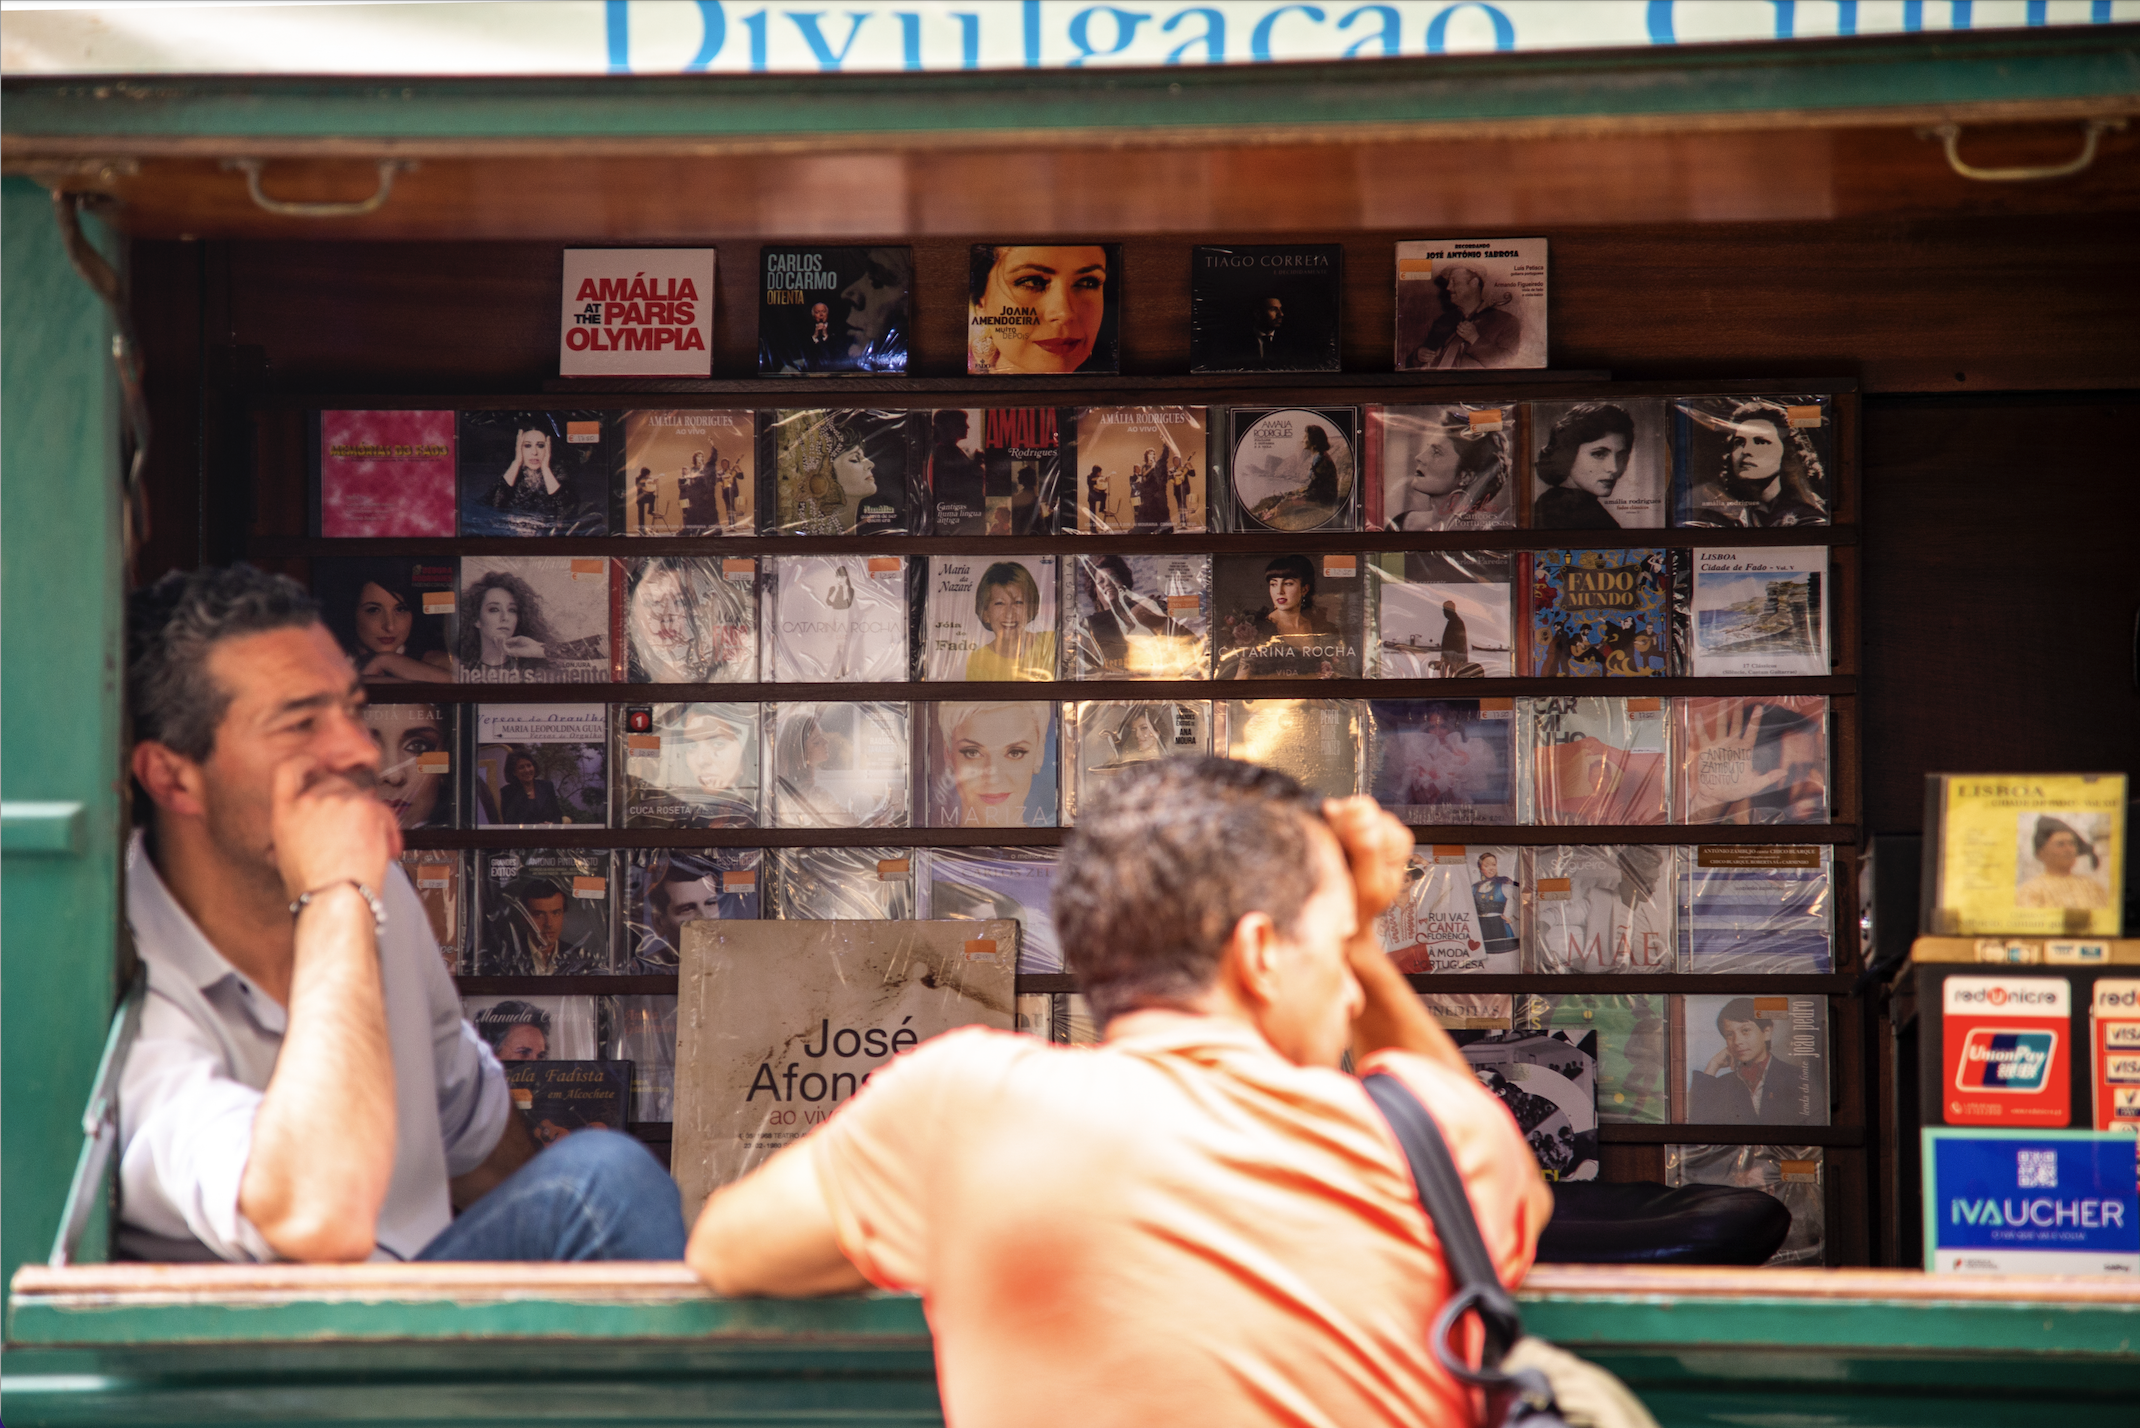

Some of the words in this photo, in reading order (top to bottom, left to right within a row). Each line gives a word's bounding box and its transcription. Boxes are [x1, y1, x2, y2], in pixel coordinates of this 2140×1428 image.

[1426, 250, 1444, 259] JOSÉ
[1446, 250, 1482, 259] ANTÓNIO
[1484, 250, 1519, 258] SABROSA
[767, 254, 822, 272] CARLOS
[1205, 255, 1255, 267] TIAGO
[1260, 255, 1329, 267] CORREIA
[575, 272, 699, 301] AMÁLIA
[767, 272, 784, 290] DO
[785, 272, 837, 290] CARMO
[1517, 281, 1544, 289] Figueiredo
[767, 290, 805, 305] OITENTA
[584, 304, 601, 313] AT
[604, 302, 695, 325] PARIS
[1000, 306, 1037, 316] JOANA
[574, 314, 601, 324] THE
[971, 316, 1041, 326] AMENDOEIRA
[565, 328, 705, 351] OLYMPIA
[649, 413, 682, 427] AMÁLIA
[683, 415, 733, 427] RODRIGUES
[1100, 411, 1135, 425] AMÁLIA
[1136, 413, 1185, 425] RODRIGUES
[1254, 429, 1293, 438] RODRIGUES
[330, 441, 392, 456] MEMÓRIAS
[395, 445, 413, 456] DO
[416, 445, 449, 456] FADO
[1008, 448, 1057, 459] Rodrigues
[936, 502, 967, 512] Cantigas
[1629, 498, 1662, 506] rodrigues
[1727, 500, 1760, 508] rodrigues
[936, 517, 960, 525] antiga
[1478, 556, 1508, 565] Paredes
[1700, 553, 1736, 561] LISBOA
[938, 563, 970, 576] Maria
[1701, 563, 1732, 571] Cidade
[1733, 563, 1742, 571] de
[1744, 563, 1767, 571] Fado
[938, 581, 973, 593] Nazaré
[1568, 572, 1634, 591] FADO
[1568, 591, 1634, 606] MUNDO
[782, 622, 847, 633] CATARINA
[851, 622, 900, 633] ROCHA
[935, 621, 962, 629] Jóia
[935, 639, 977, 651] Fado
[1218, 645, 1295, 658] CATARINA
[1303, 645, 1356, 658] ROCHA
[460, 664, 521, 684] helena
[524, 667, 608, 684] sarmento
[1276, 669, 1298, 677] VIDA
[1533, 697, 1578, 715] CAR
[408, 710, 443, 720] LEAL
[635, 715, 643, 727] 1
[502, 725, 528, 733] MARIA
[530, 725, 581, 733] LEOPOLDINA
[582, 725, 603, 733] GUIA
[1534, 715, 1560, 732] MI
[1180, 728, 1192, 736] ANA
[1175, 736, 1196, 744] MOURA
[1958, 785, 2044, 797] LISBOA
[629, 806, 655, 815] CUCA
[656, 806, 691, 815] ROSETA
[940, 806, 1048, 825] MARIZA
[528, 857, 555, 866] ANTÓNIO
[1017, 852, 1043, 860] melhor
[1429, 913, 1446, 921] RUI
[1448, 913, 1469, 921] VAZ
[1428, 922, 1470, 933] CANTA
[1427, 931, 1471, 940] FLORÊNCIA
[1429, 946, 1435, 957] À
[1438, 949, 1469, 957] MODA
[1566, 925, 1661, 966] MÃE
[475, 1008, 533, 1024] Manuela
[1788, 1000, 1819, 1031] pedro
[804, 1015, 918, 1058] José
[1787, 1034, 1820, 1058] joão
[1969, 1045, 2046, 1069] UnionPay
[545, 1068, 604, 1083] Fadista
[1799, 1061, 1809, 1081] fonte
[547, 1091, 562, 1099] em
[563, 1089, 615, 1099] Alcochete
[1799, 1083, 1809, 1094] da
[1799, 1096, 1810, 1116] lenda
[770, 1110, 797, 1125] ao
[1951, 1199, 2124, 1228] IVAUCHER
[2016, 1231, 2033, 1240] QUE
